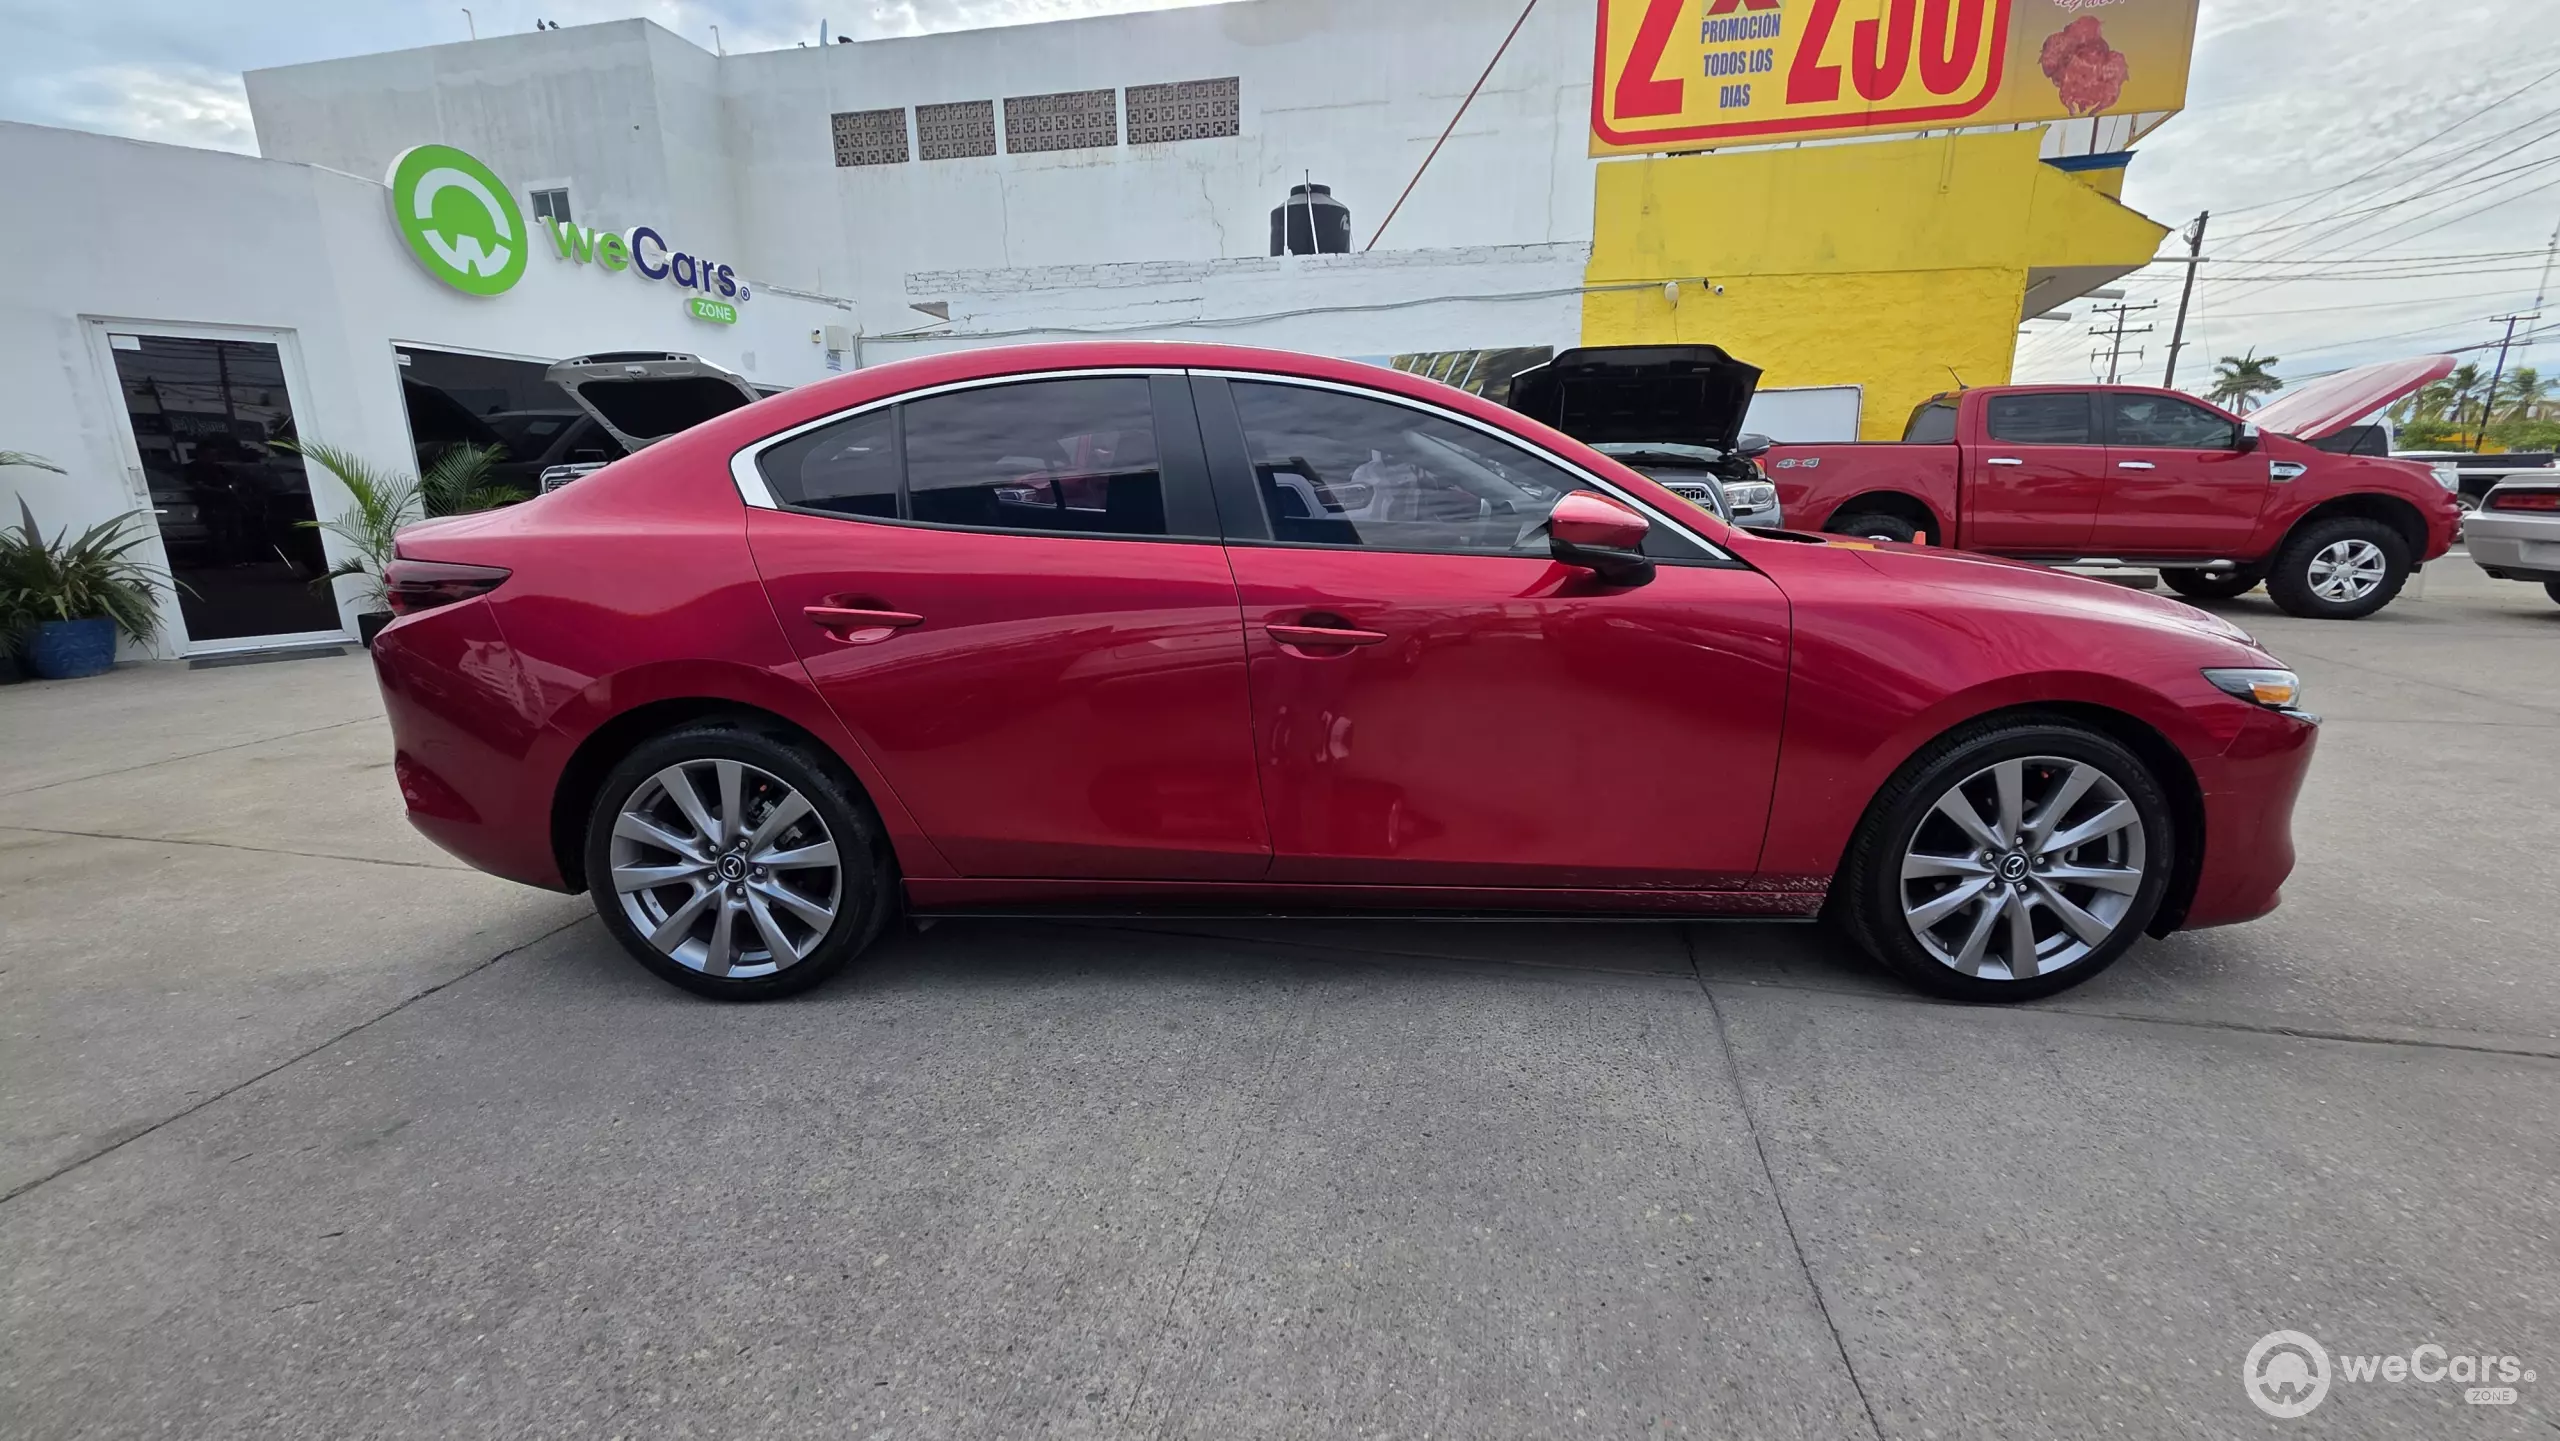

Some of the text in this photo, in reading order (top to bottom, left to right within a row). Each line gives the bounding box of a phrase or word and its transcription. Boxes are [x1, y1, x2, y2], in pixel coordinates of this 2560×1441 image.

[1701, 13, 1781, 44] PROMOCIÓN
[1704, 48, 1774, 77] TODOS LOS
[1720, 84, 1751, 108] DIAS
[697, 302, 732, 321] ZONE
